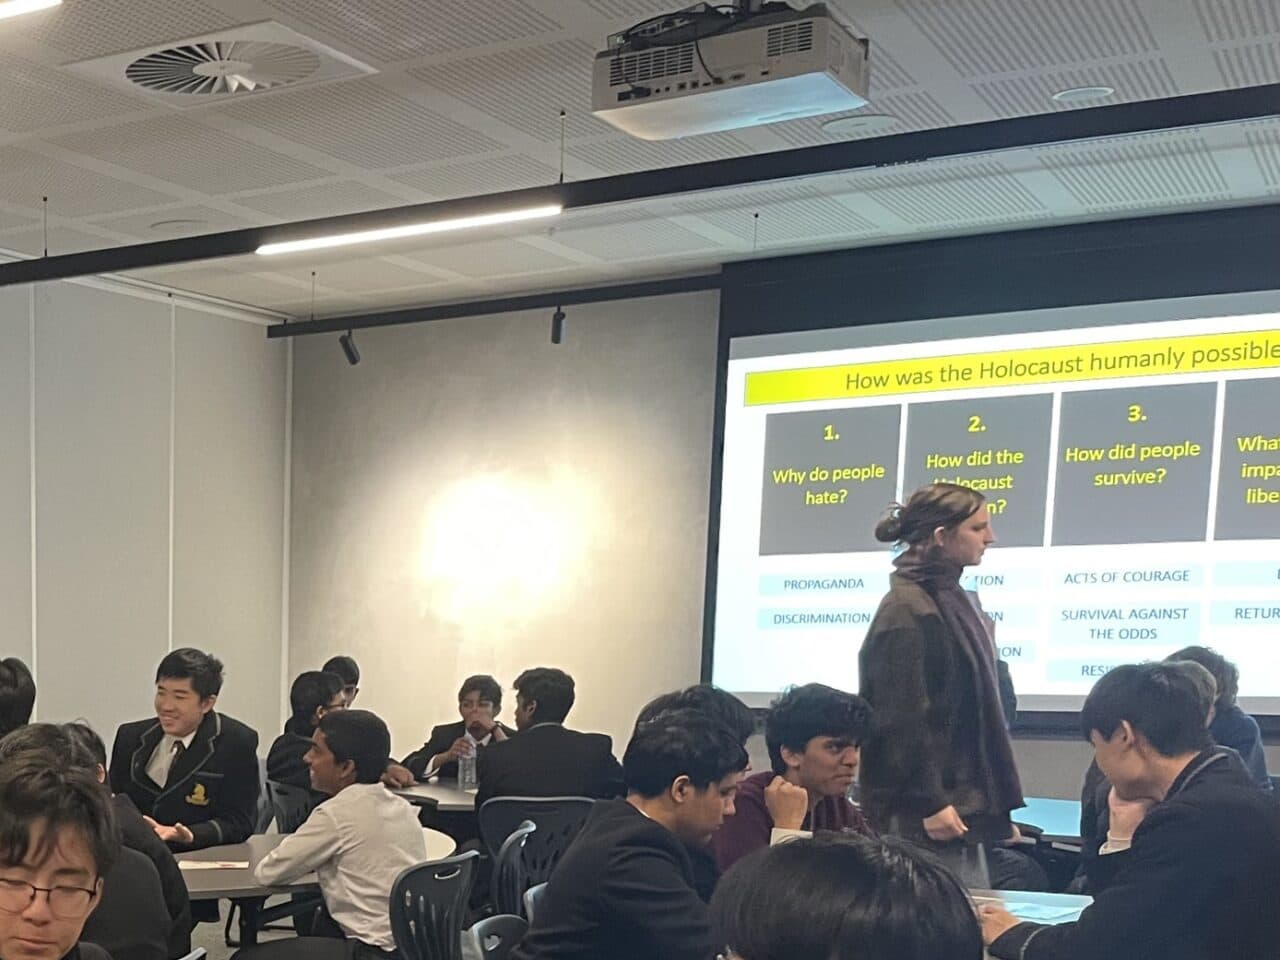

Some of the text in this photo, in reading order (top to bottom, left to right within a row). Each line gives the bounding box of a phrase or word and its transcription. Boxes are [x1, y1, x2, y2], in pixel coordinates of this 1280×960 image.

[846, 340, 1280, 390] How was the Holocaust humanly possible
[1128, 405, 1147, 422] 3.
[968, 416, 986, 432] 2.
[824, 425, 840, 441] 1.
[1065, 441, 1201, 462] How did people
[1237, 435, 1280, 452] Wha
[927, 449, 1024, 469] How did the
[773, 464, 885, 485] Why do people
[933, 475, 1014, 490] locaust
[1094, 468, 1167, 486] survive?
[805, 489, 848, 505] hate?
[784, 578, 865, 590] PROPAGANDA
[1064, 570, 1190, 585] ACTS OF COURAGE
[773, 613, 871, 625] DISCRIMINATION
[1061, 607, 1189, 621] SURVIVAL AGAINST
[1089, 628, 1157, 640] THE ODDS
